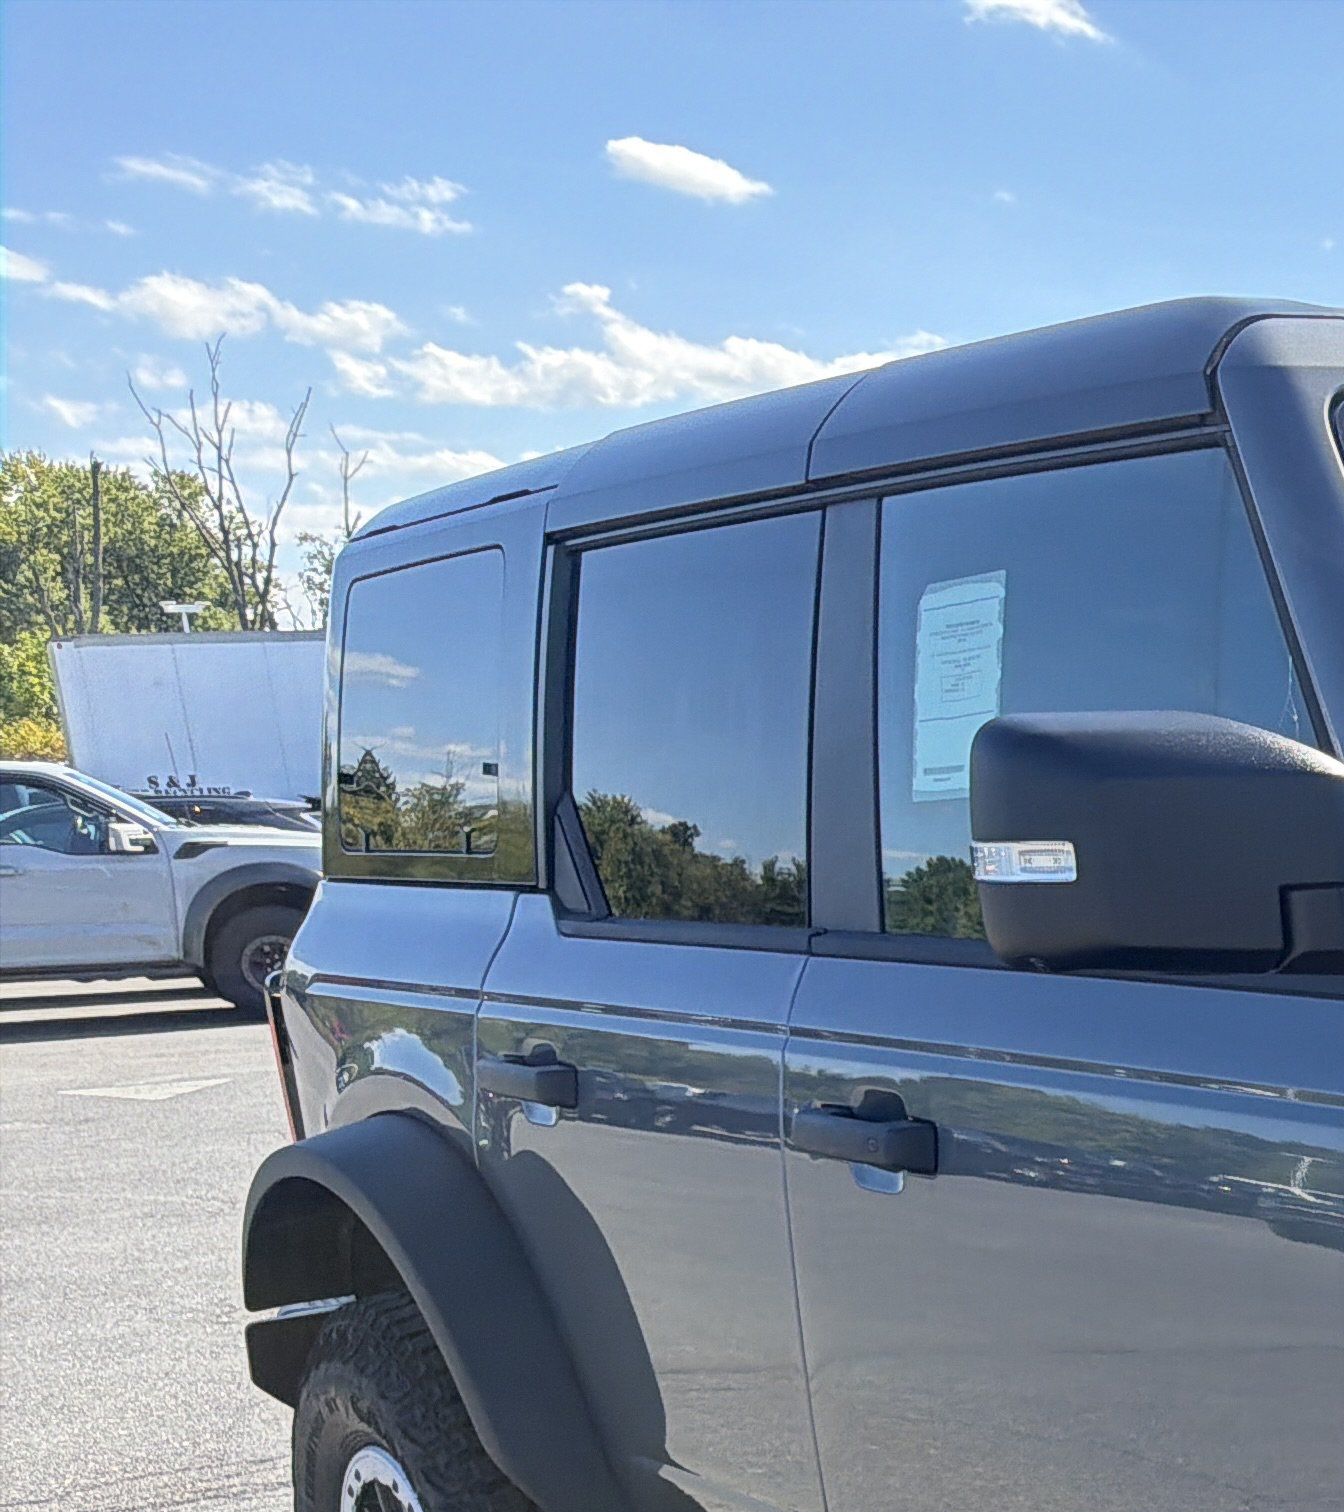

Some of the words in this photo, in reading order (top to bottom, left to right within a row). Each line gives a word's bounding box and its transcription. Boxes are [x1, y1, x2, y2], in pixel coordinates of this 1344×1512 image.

[146, 775, 160, 789] S
[166, 775, 180, 788] &
[186, 775, 197, 787] J
